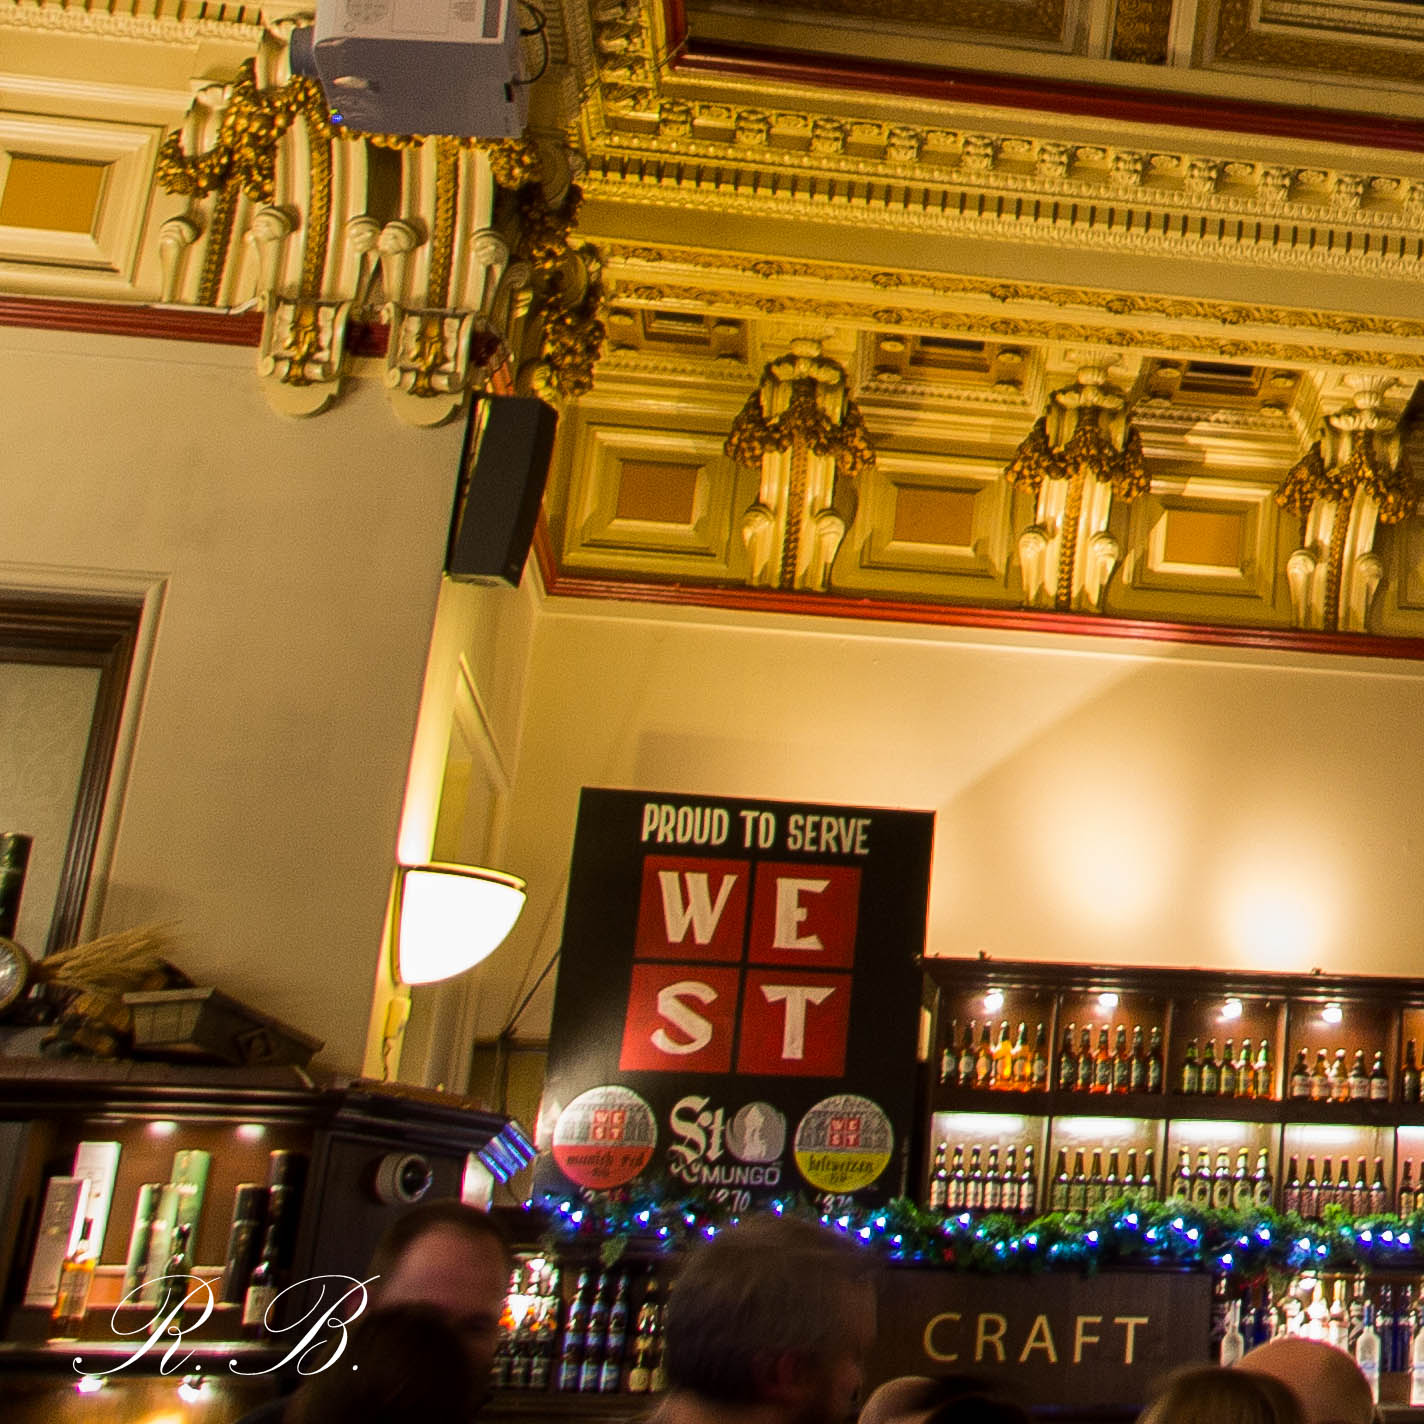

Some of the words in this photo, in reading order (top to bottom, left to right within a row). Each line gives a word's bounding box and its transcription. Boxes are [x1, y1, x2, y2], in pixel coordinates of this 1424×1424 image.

[641, 803, 729, 846] PROUD
[740, 810, 776, 849] TO
[787, 814, 872, 855] SERVE
[701, 1165, 781, 1186] MUNGO
[922, 1312, 1150, 1365] CRAFT
